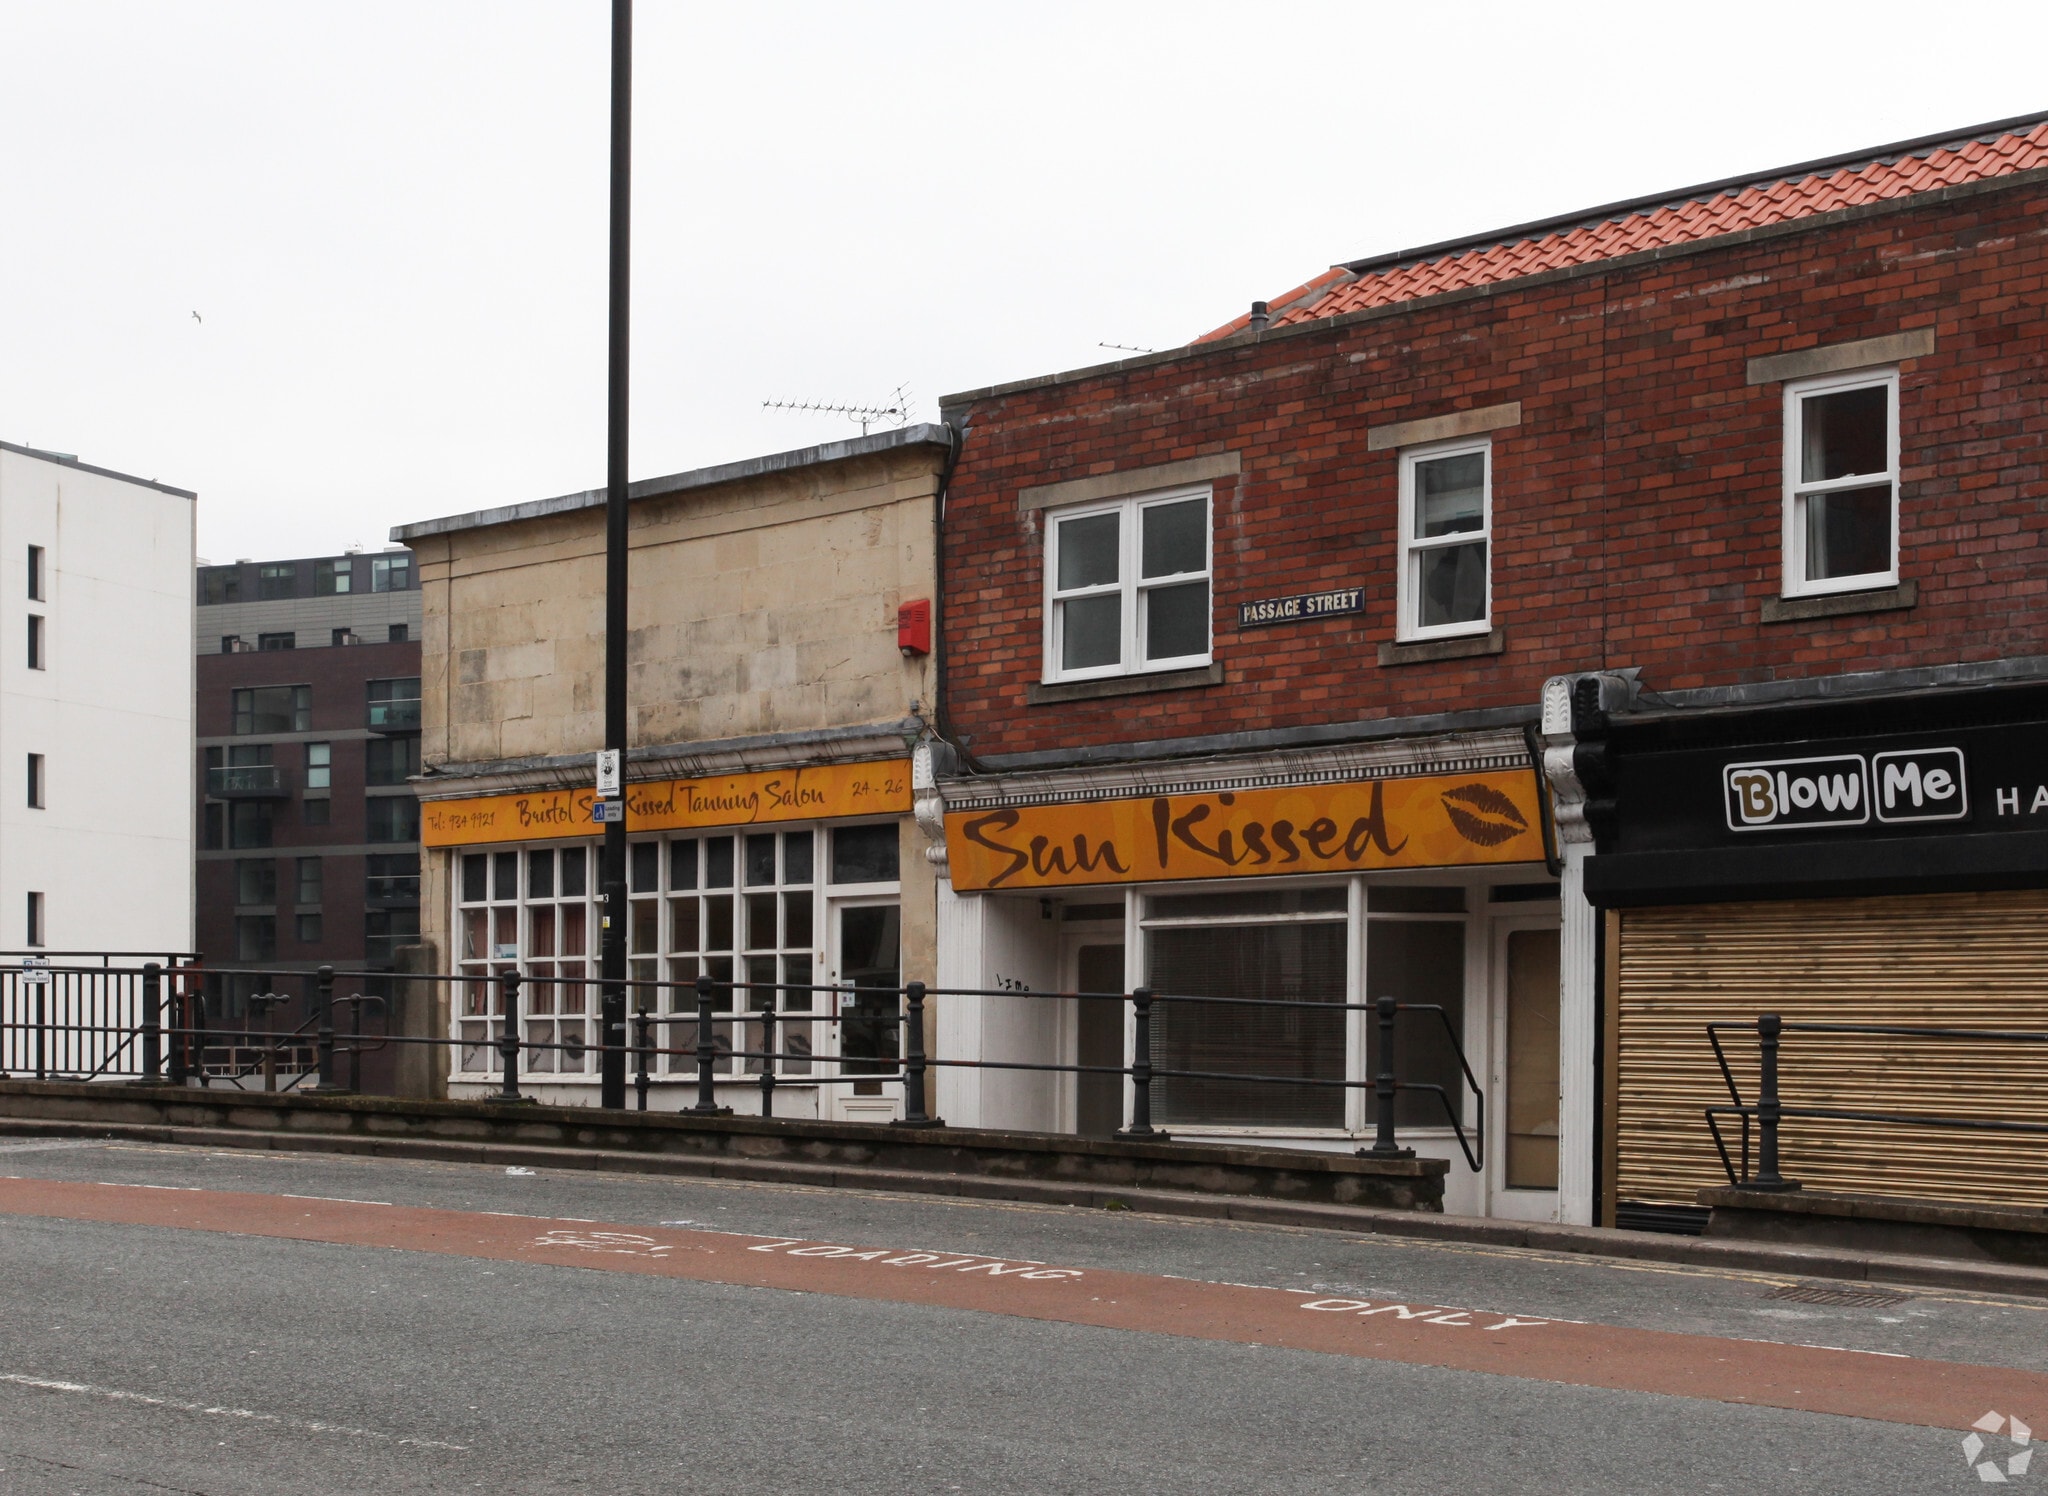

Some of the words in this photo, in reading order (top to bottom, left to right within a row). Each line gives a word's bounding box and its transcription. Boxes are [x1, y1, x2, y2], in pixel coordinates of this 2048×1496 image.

[1243, 600, 1301, 622] PASSAGE
[1306, 592, 1359, 614] STREET
[516, 790, 577, 827] Bristol
[679, 784, 759, 824] Tanning
[764, 769, 825, 810] Salon
[852, 781, 870, 797] 24
[884, 779, 903, 794] 26
[1730, 769, 1859, 823] Blow
[1883, 762, 1956, 809] Me
[448, 815, 468, 831] 934
[470, 811, 496, 829] 9921
[963, 809, 1130, 888] Sun
[1152, 780, 1408, 869] Kissed
[747, 1242, 1084, 1279] LOADING
[1300, 1299, 1549, 1330] ONLY
